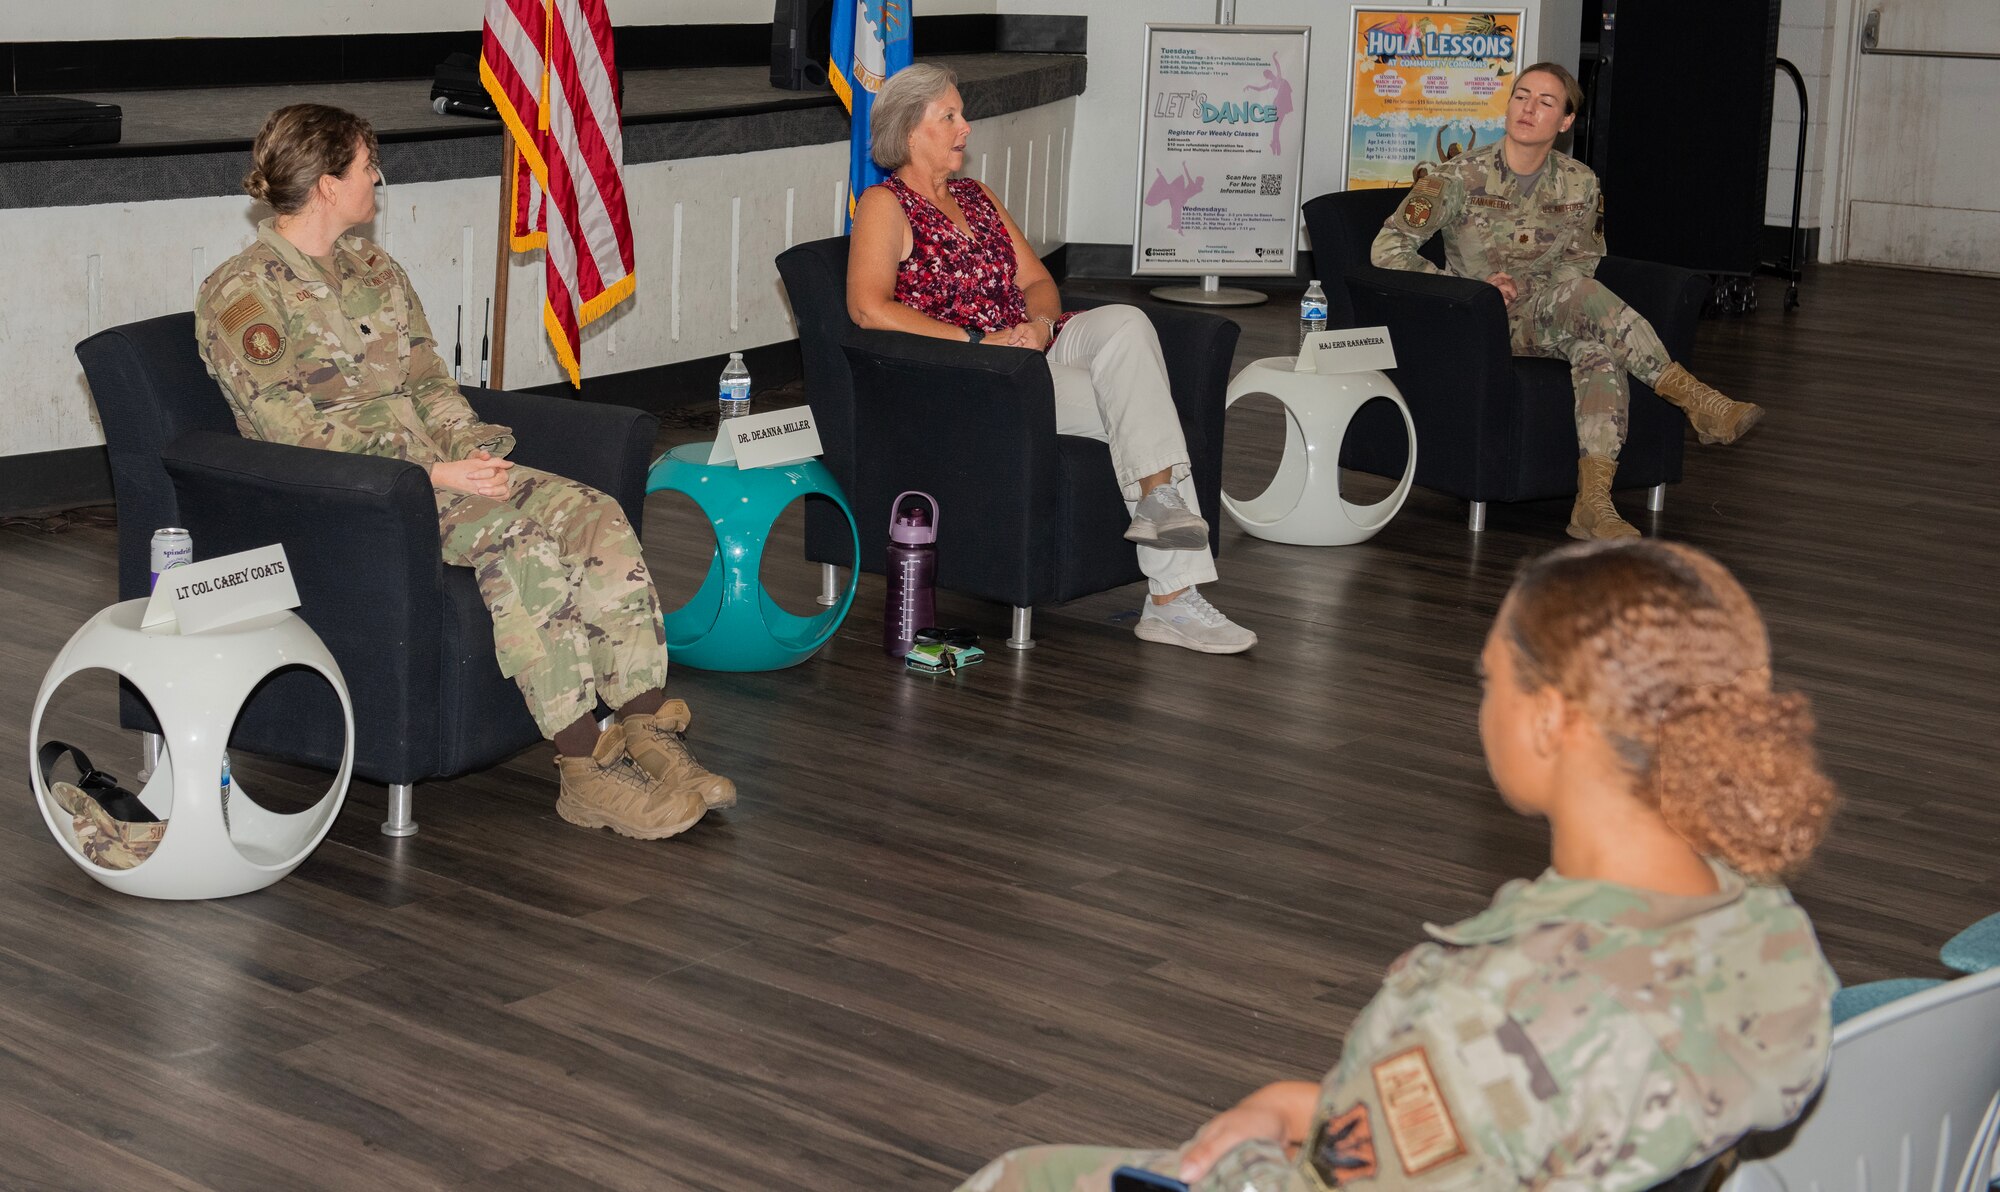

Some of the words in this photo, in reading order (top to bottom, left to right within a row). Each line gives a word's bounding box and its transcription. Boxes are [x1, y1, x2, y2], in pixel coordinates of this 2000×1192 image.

[1368, 30, 1422, 55] HULA
[1426, 31, 1512, 56] LESSONS
[1400, 60, 1446, 68] COMMUNITY
[1449, 60, 1488, 68] COMMONS
[1154, 90, 1207, 118] LET'S
[1201, 101, 1279, 124] DANCE
[1167, 129, 1195, 137] Register
[1209, 130, 1233, 138] Weekly
[1182, 206, 1228, 214] Wednesdays:
[1319, 342, 1332, 350] MAJ
[1332, 340, 1347, 349] ERIN
[1347, 337, 1385, 348] RANAWEERA
[738, 433, 751, 444] DR.
[751, 425, 783, 441] DEANNA
[783, 419, 811, 434] MILLER
[176, 585, 191, 600] LT
[191, 580, 213, 596] COL
[213, 567, 249, 590] CAREY
[251, 561, 285, 580] COATS
